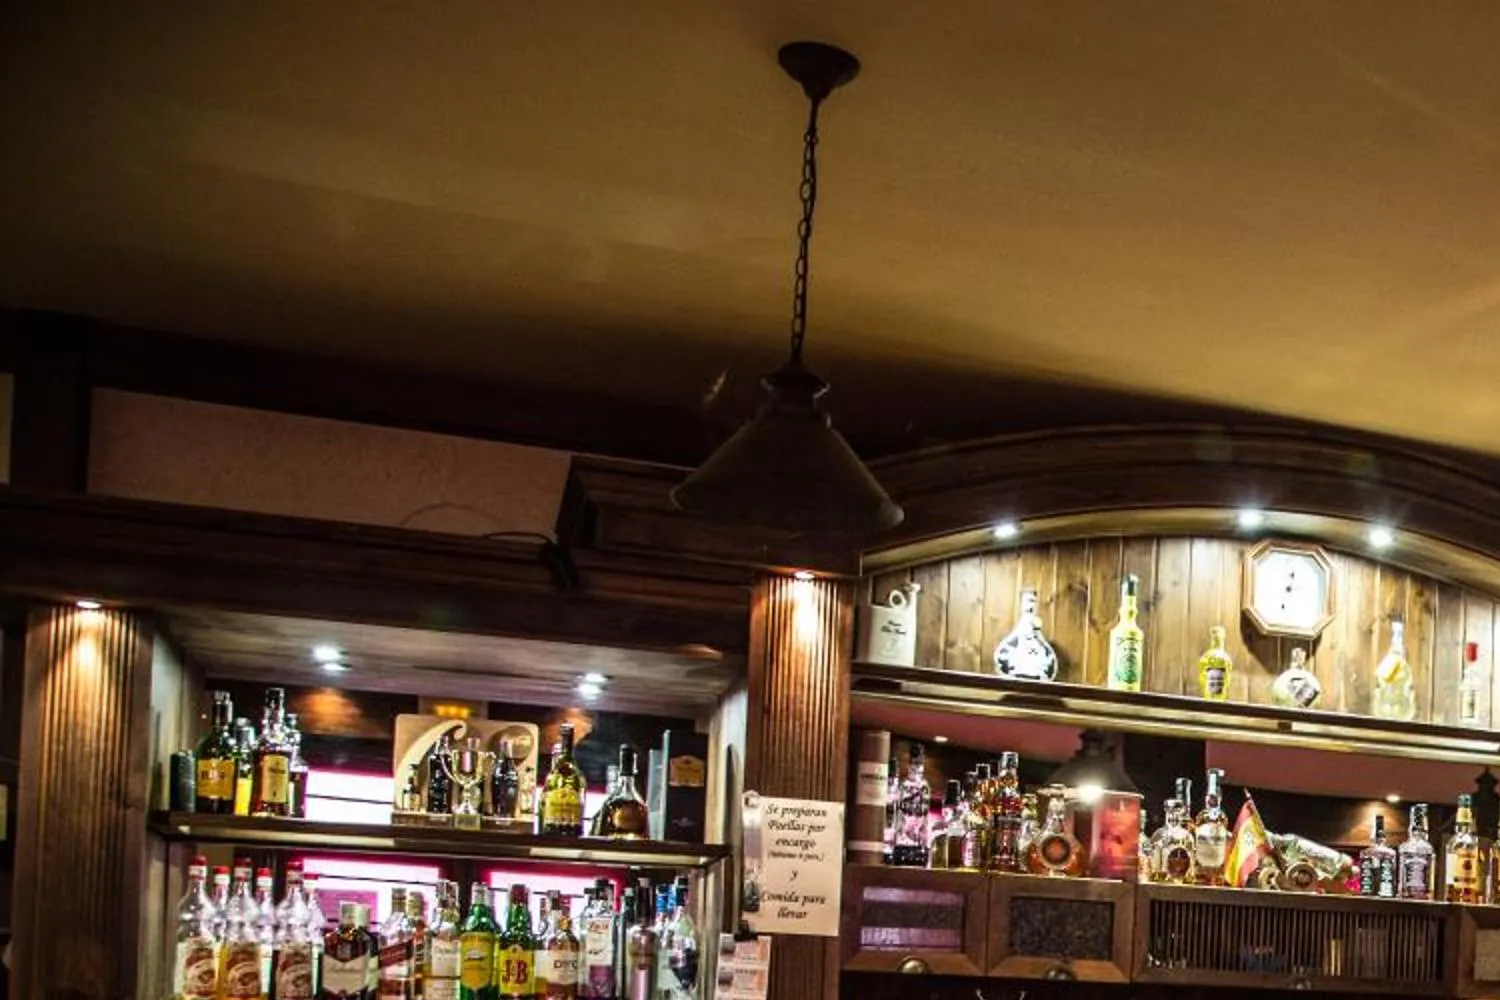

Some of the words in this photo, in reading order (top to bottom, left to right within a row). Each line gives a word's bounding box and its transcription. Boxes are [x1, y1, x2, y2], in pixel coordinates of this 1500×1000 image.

[766, 804, 779, 815] Se
[781, 807, 827, 818] preparan
[775, 838, 816, 850] encargo
[789, 870, 798, 881] y
[801, 895, 826, 906] para
[777, 907, 808, 918] llevar
